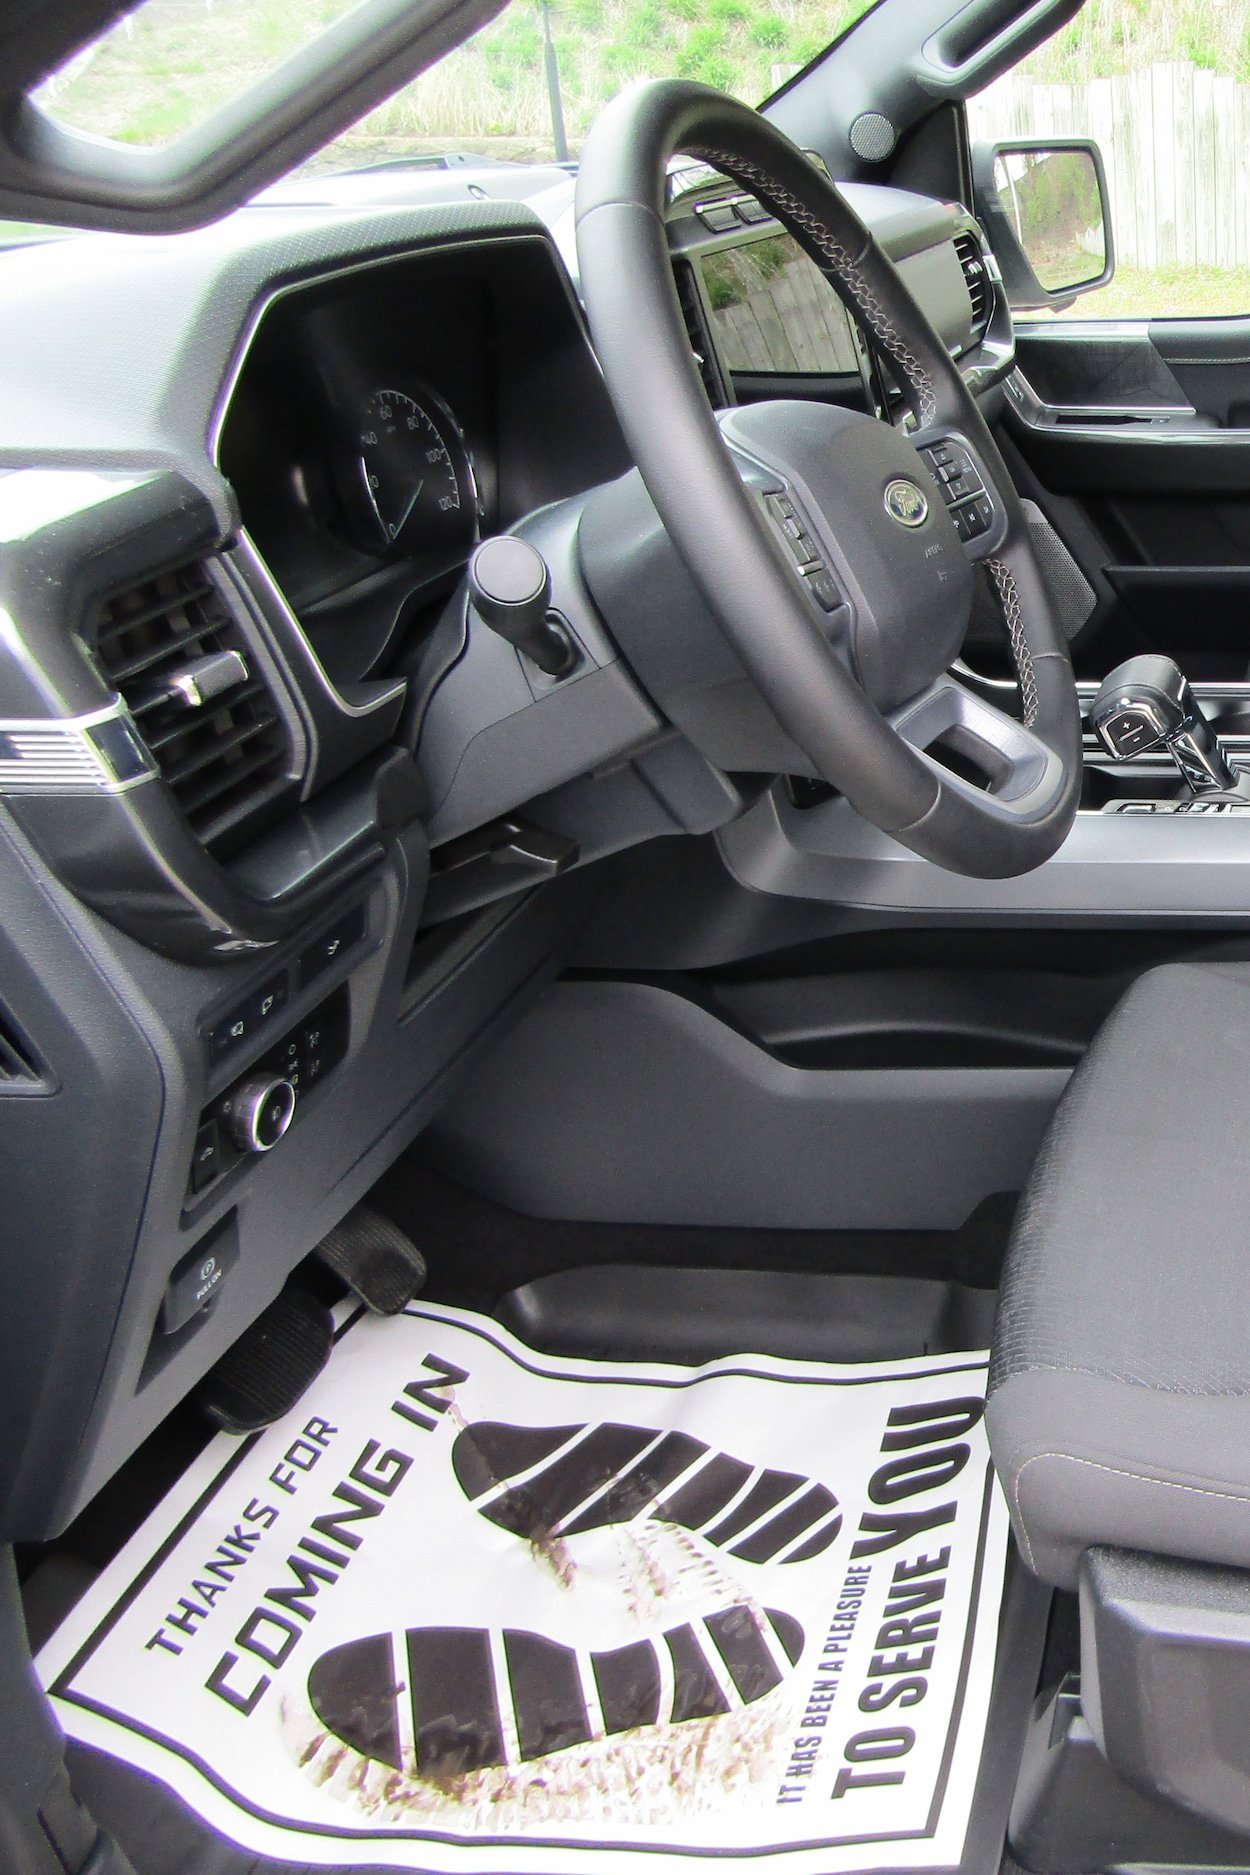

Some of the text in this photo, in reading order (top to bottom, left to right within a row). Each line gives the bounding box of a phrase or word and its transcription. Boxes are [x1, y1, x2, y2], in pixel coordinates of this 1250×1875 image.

[380, 405, 392, 420] 60
[407, 415, 419, 430] 80
[425, 448, 441, 463] 100
[145, 1416, 338, 1656] THANKS FOR
[204, 1353, 470, 1717] COMING IN
[831, 1395, 986, 1800] TO SERVE YOU
[776, 1565, 872, 1804] IT HAS BEEN A PLEASURE
